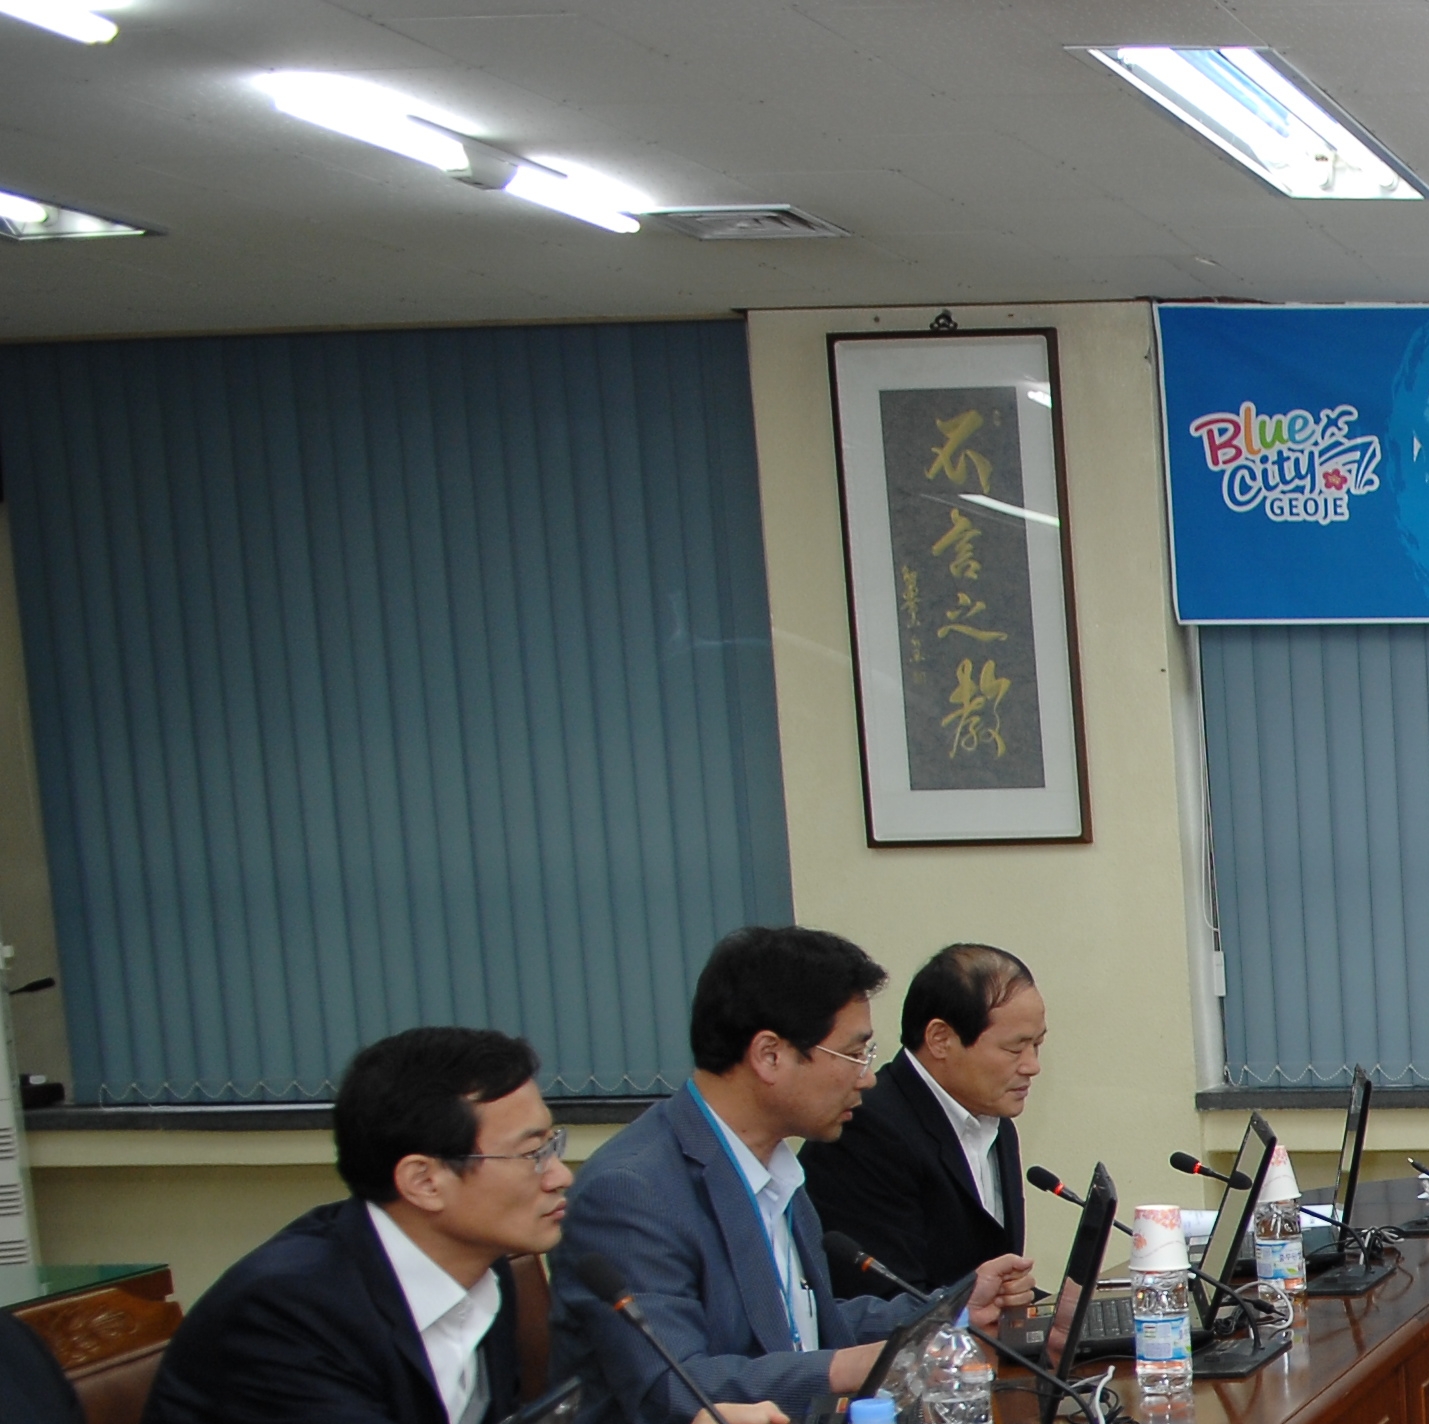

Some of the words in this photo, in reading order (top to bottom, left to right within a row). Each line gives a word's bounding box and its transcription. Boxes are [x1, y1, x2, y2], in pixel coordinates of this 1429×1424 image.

[1194, 406, 1316, 467] Blue
[1227, 449, 1317, 507] City
[1269, 497, 1345, 520] GEOJE
